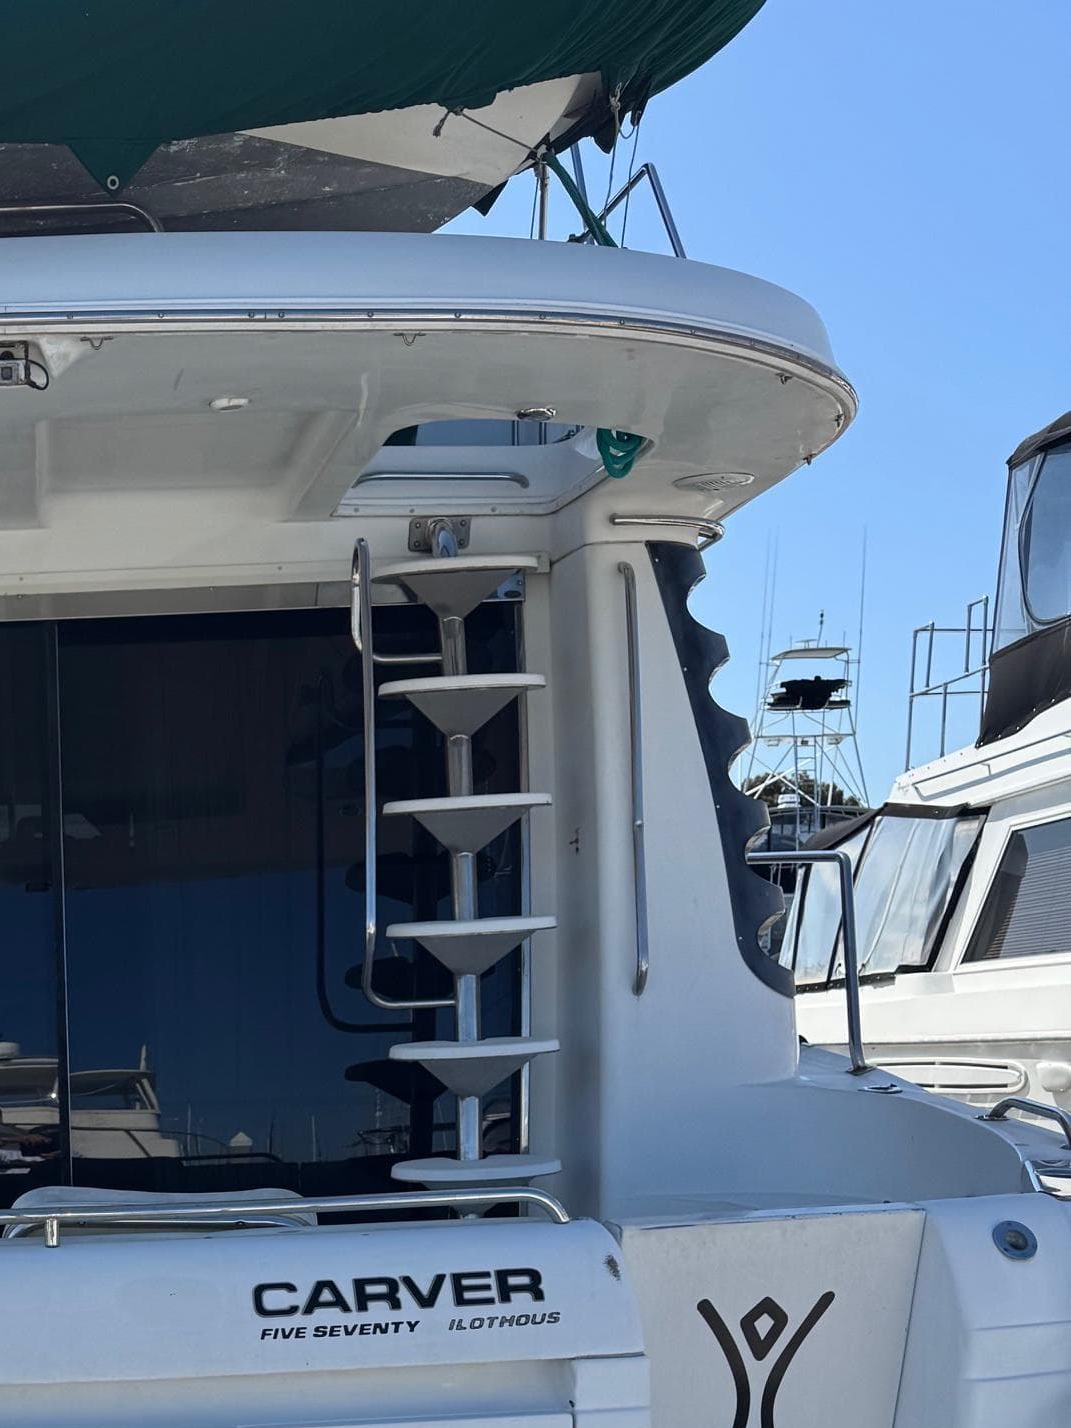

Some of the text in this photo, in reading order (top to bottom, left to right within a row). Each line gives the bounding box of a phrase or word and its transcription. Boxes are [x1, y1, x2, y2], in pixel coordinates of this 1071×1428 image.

[251, 1267, 546, 1318] CARVER
[260, 1311, 561, 1341] FIVE SEVENTY ILOTHOUS
